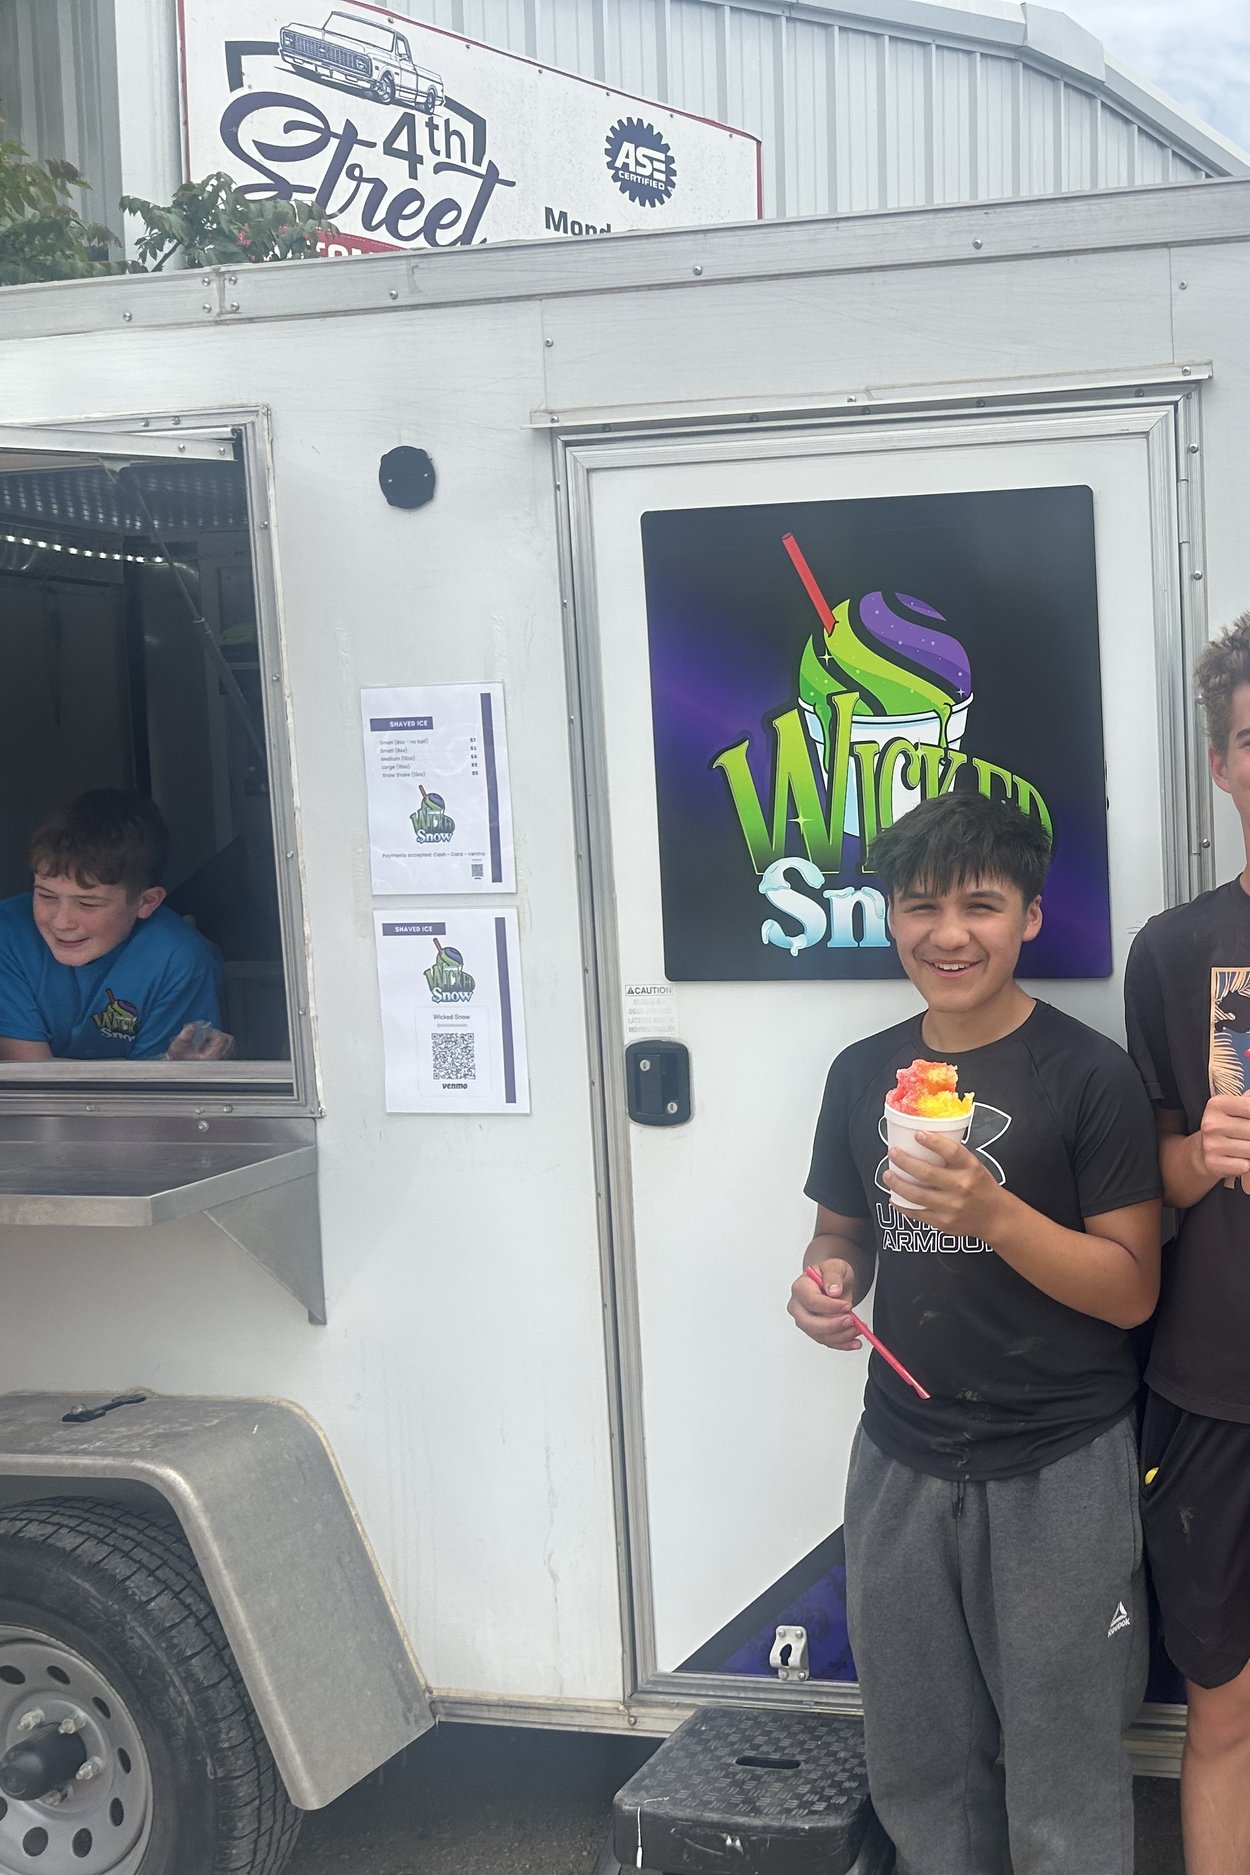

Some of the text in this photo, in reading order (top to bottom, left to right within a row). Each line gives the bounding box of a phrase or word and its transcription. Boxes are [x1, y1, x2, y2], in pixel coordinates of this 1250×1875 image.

[383, 112, 468, 181] 4th
[219, 91, 516, 247] Street
[613, 140, 666, 182] ASE
[618, 170, 665, 191] CERTIFIED
[389, 720, 416, 728] SHAVED
[417, 829, 454, 844] Snow
[758, 856, 894, 957] Sn
[432, 987, 473, 1003] Snow
[634, 986, 672, 995] CAUTION
[882, 1229, 994, 1254] ARMOU
